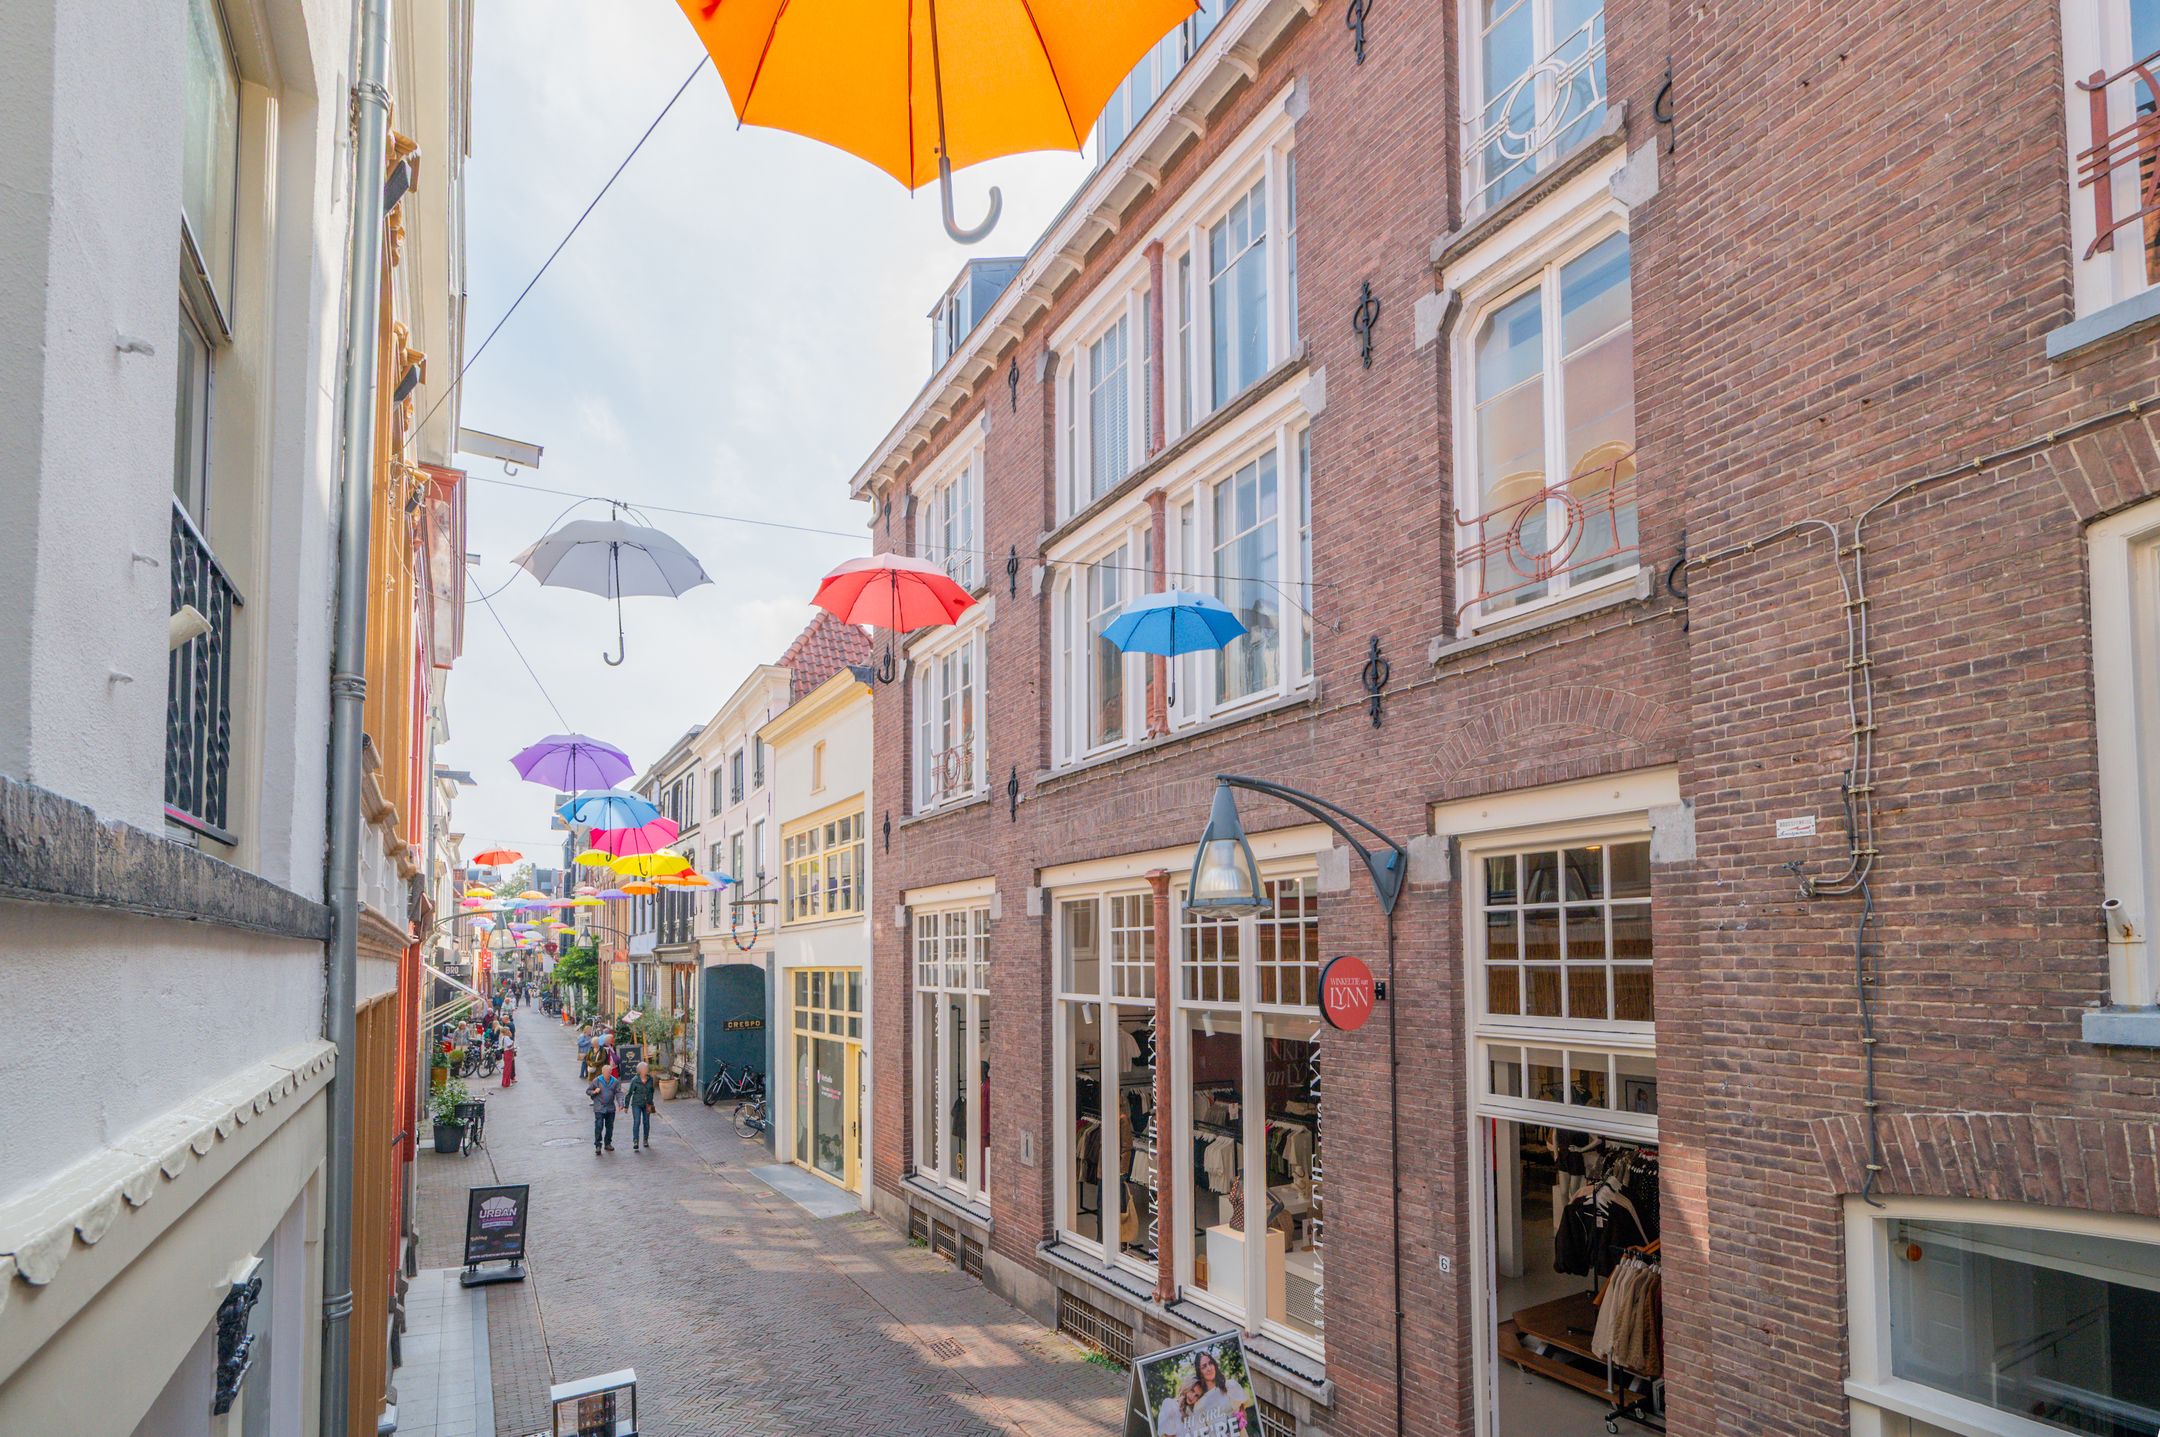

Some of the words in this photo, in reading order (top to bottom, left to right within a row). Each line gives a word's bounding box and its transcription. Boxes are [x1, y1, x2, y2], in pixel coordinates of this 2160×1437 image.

[1330, 987, 1369, 1011] LYNN
[727, 1020, 761, 1029] CRESPO
[479, 1207, 518, 1219] URBAN
[1441, 1257, 1448, 1270] 6
[1183, 1414, 1196, 1429] HI
